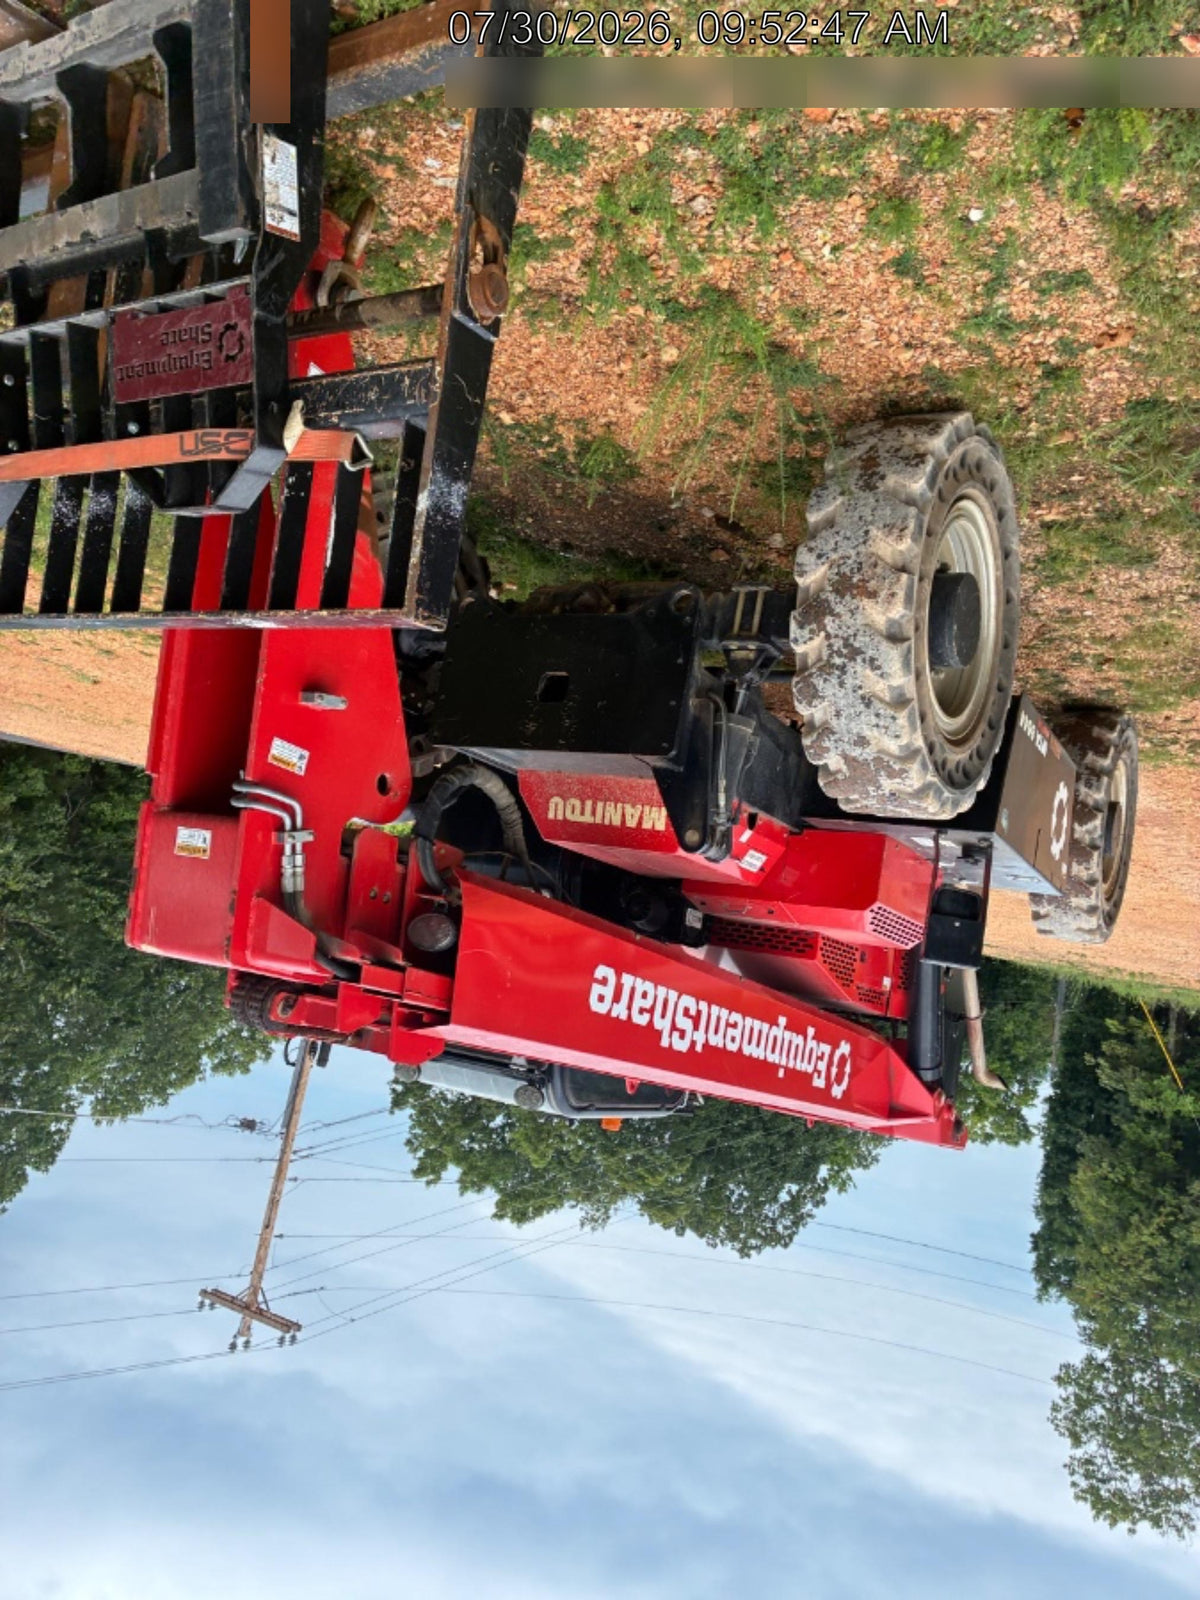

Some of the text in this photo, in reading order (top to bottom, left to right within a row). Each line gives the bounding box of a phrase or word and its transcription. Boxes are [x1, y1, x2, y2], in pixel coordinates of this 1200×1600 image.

[160, 323, 213, 346] Share
[117, 350, 213, 381] Equipment
[547, 796, 668, 832] MANITOU
[588, 964, 832, 1089] EquipmentShare
